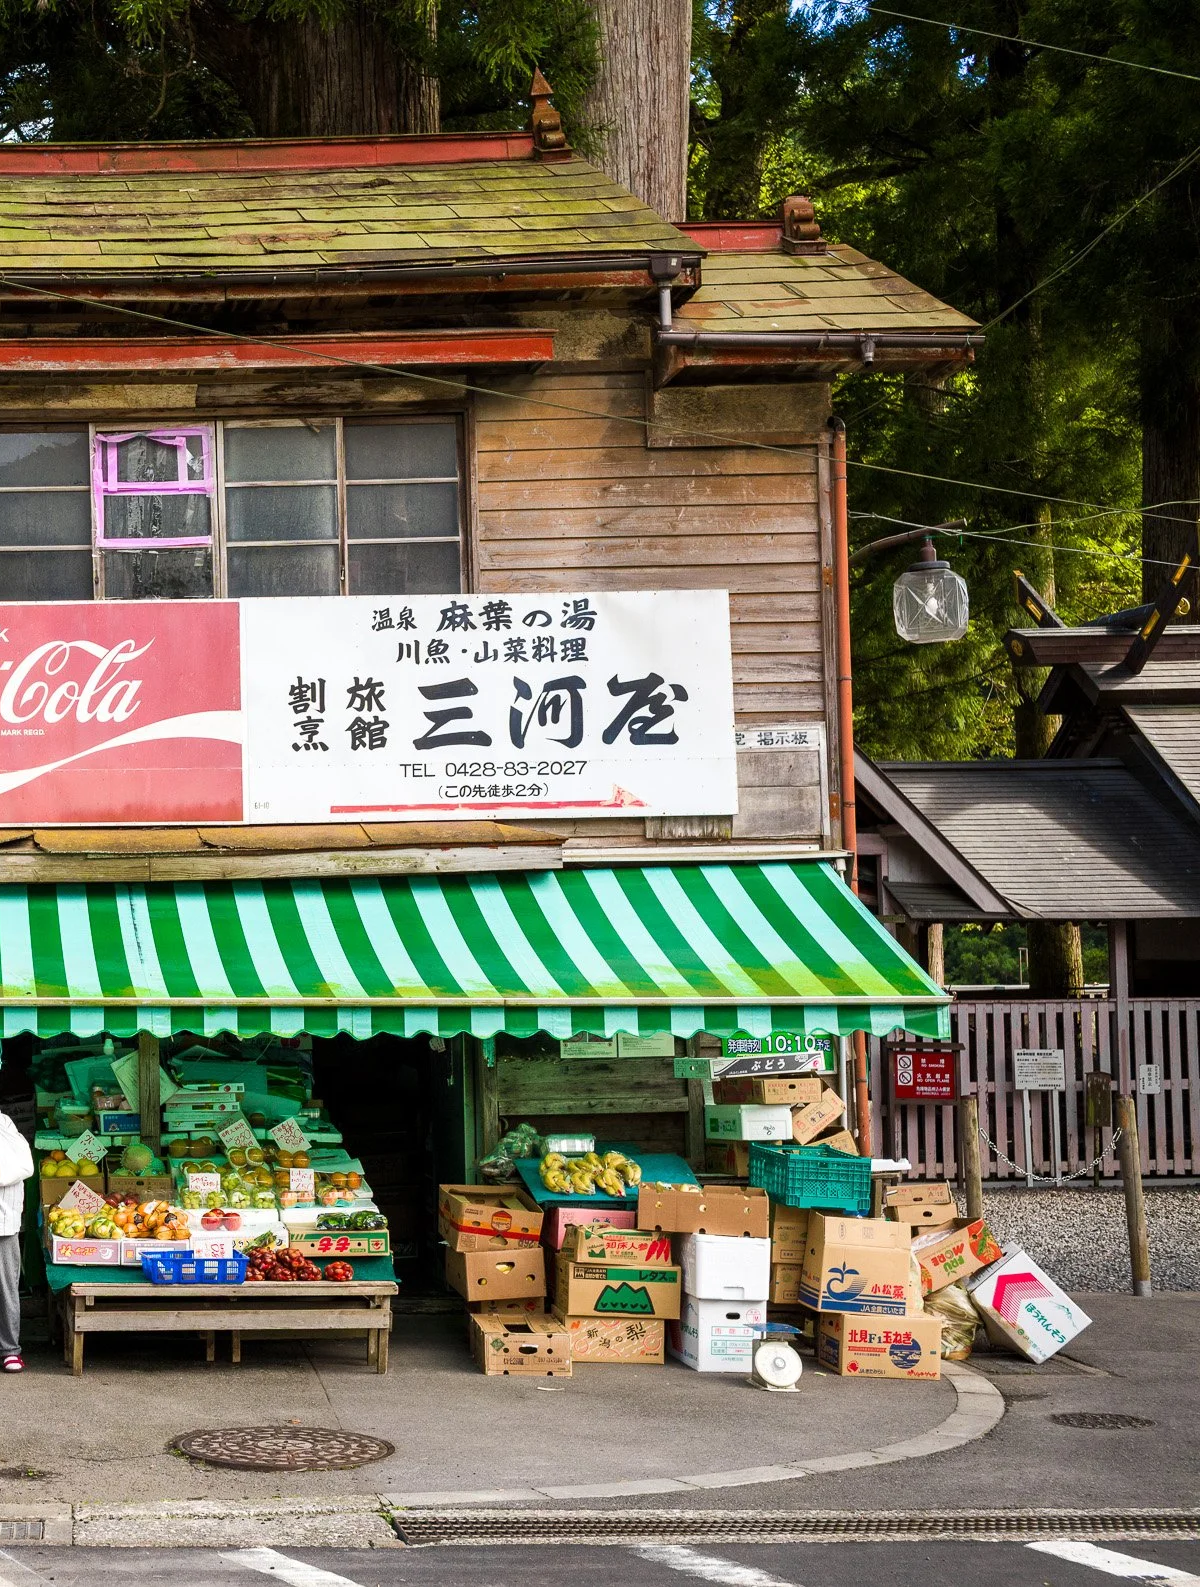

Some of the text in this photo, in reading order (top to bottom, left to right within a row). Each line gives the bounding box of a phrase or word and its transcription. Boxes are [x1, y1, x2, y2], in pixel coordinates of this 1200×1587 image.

[371, 599, 598, 633] 温泉 麻葉の湯
[396, 636, 590, 665] 川魚・山菜料理
[288, 676, 330, 752] 割烹
[345, 676, 389, 752] 旅館
[412, 672, 689, 750] 三河屋
[757, 731, 809, 746] 掲示板
[400, 760, 588, 778] TEL 0428-83-2027
[727, 1034, 832, 1053] 発車時刻 10:10 予定
[751, 1059, 786, 1071] ぶどう
[317, 1236, 351, 1253] もも
[931, 1243, 965, 1267] MORE
[639, 1270, 668, 1282] レタス
[870, 1283, 905, 1300] 小松菜
[1024, 1302, 1067, 1344] ほうれんそう
[586, 1321, 647, 1349] 新潟の梨
[848, 1329, 912, 1345] 北見F1玉ねぎ
